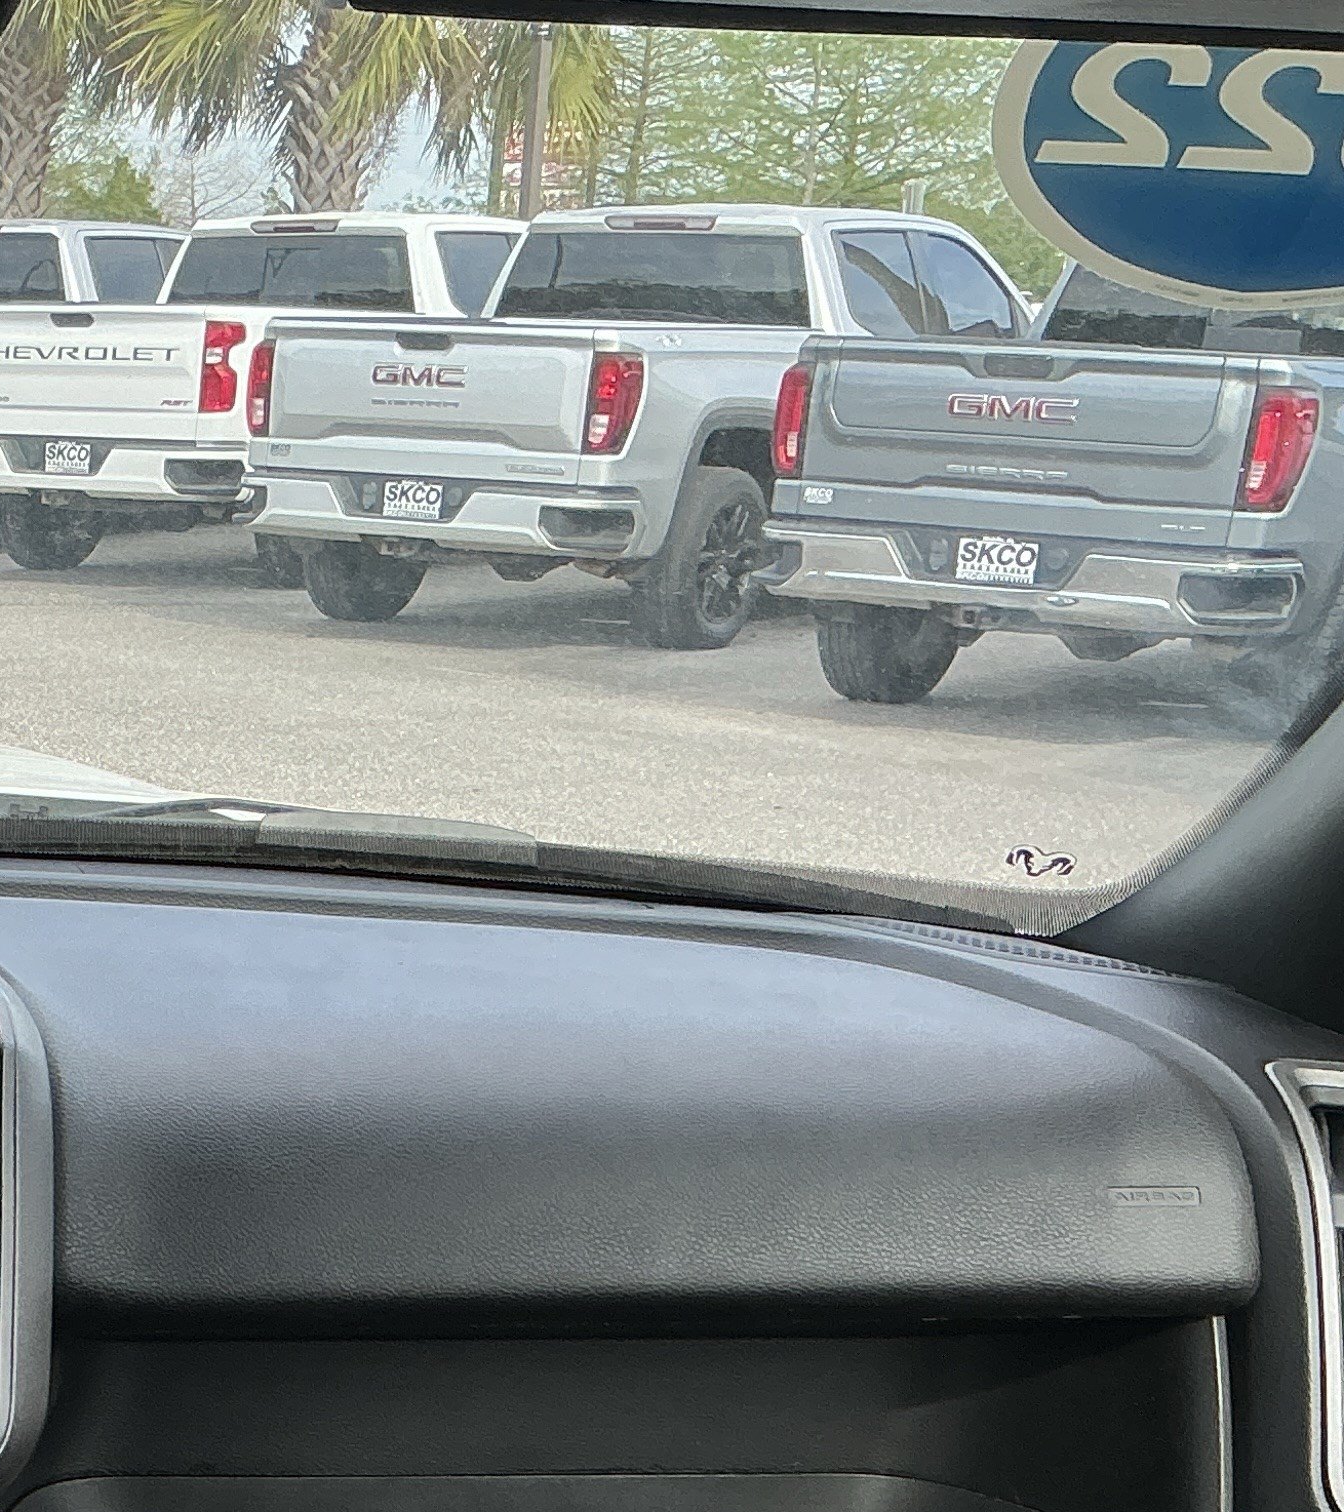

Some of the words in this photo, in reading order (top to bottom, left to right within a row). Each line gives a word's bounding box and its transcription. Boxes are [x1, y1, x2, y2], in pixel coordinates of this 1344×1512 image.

[371, 362, 468, 389] GMC
[371, 398, 461, 409] SIERRA
[947, 393, 1080, 425] GMC
[46, 445, 89, 463] SKCO
[945, 464, 1069, 481] SIERRA
[385, 482, 442, 505] SKCO
[959, 541, 1039, 569] SKCO
[1114, 1191, 1195, 1202] AIRBAG
